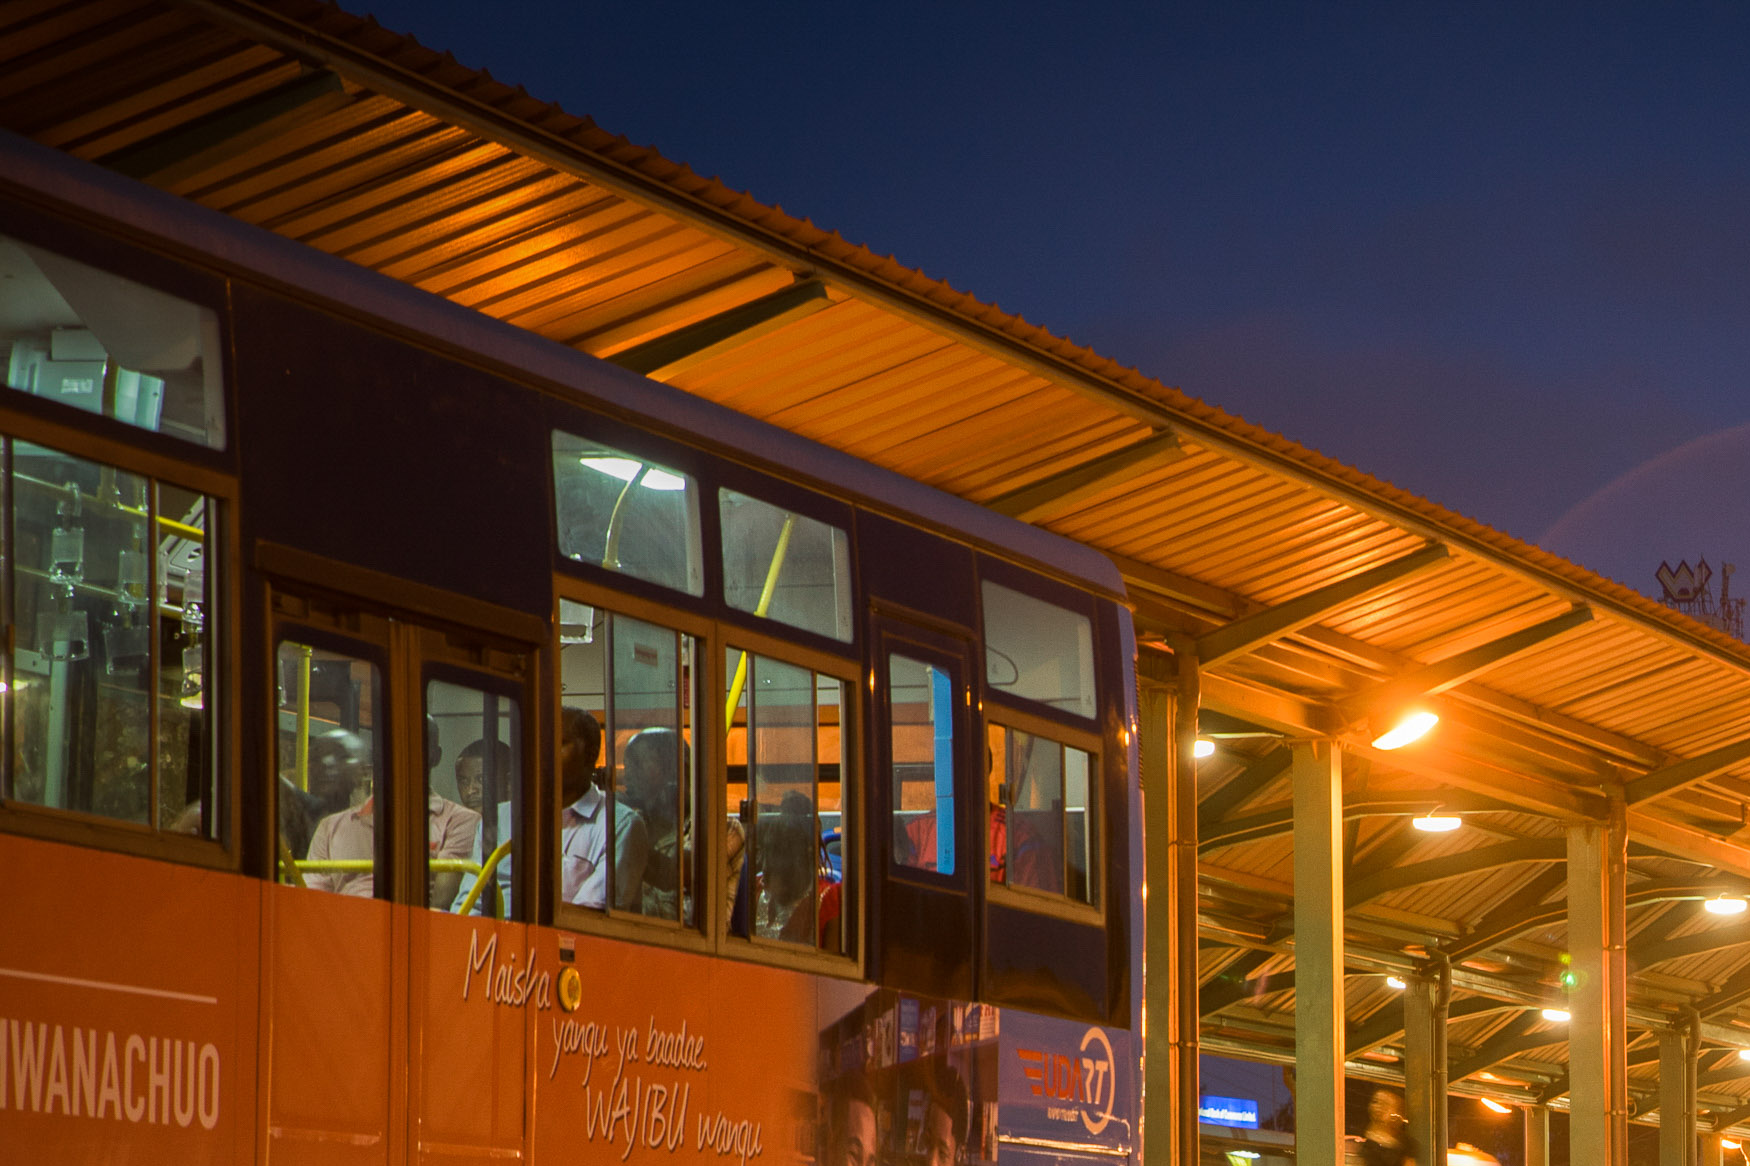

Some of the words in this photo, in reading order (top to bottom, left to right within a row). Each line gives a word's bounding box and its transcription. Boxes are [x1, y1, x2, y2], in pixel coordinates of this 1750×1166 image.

[463, 928, 551, 1009] Maisha
[550, 1017, 608, 1087] yangu
[616, 1025, 638, 1083] ya
[645, 1014, 707, 1070] baadae.
[586, 1075, 690, 1161] WAJIBU
